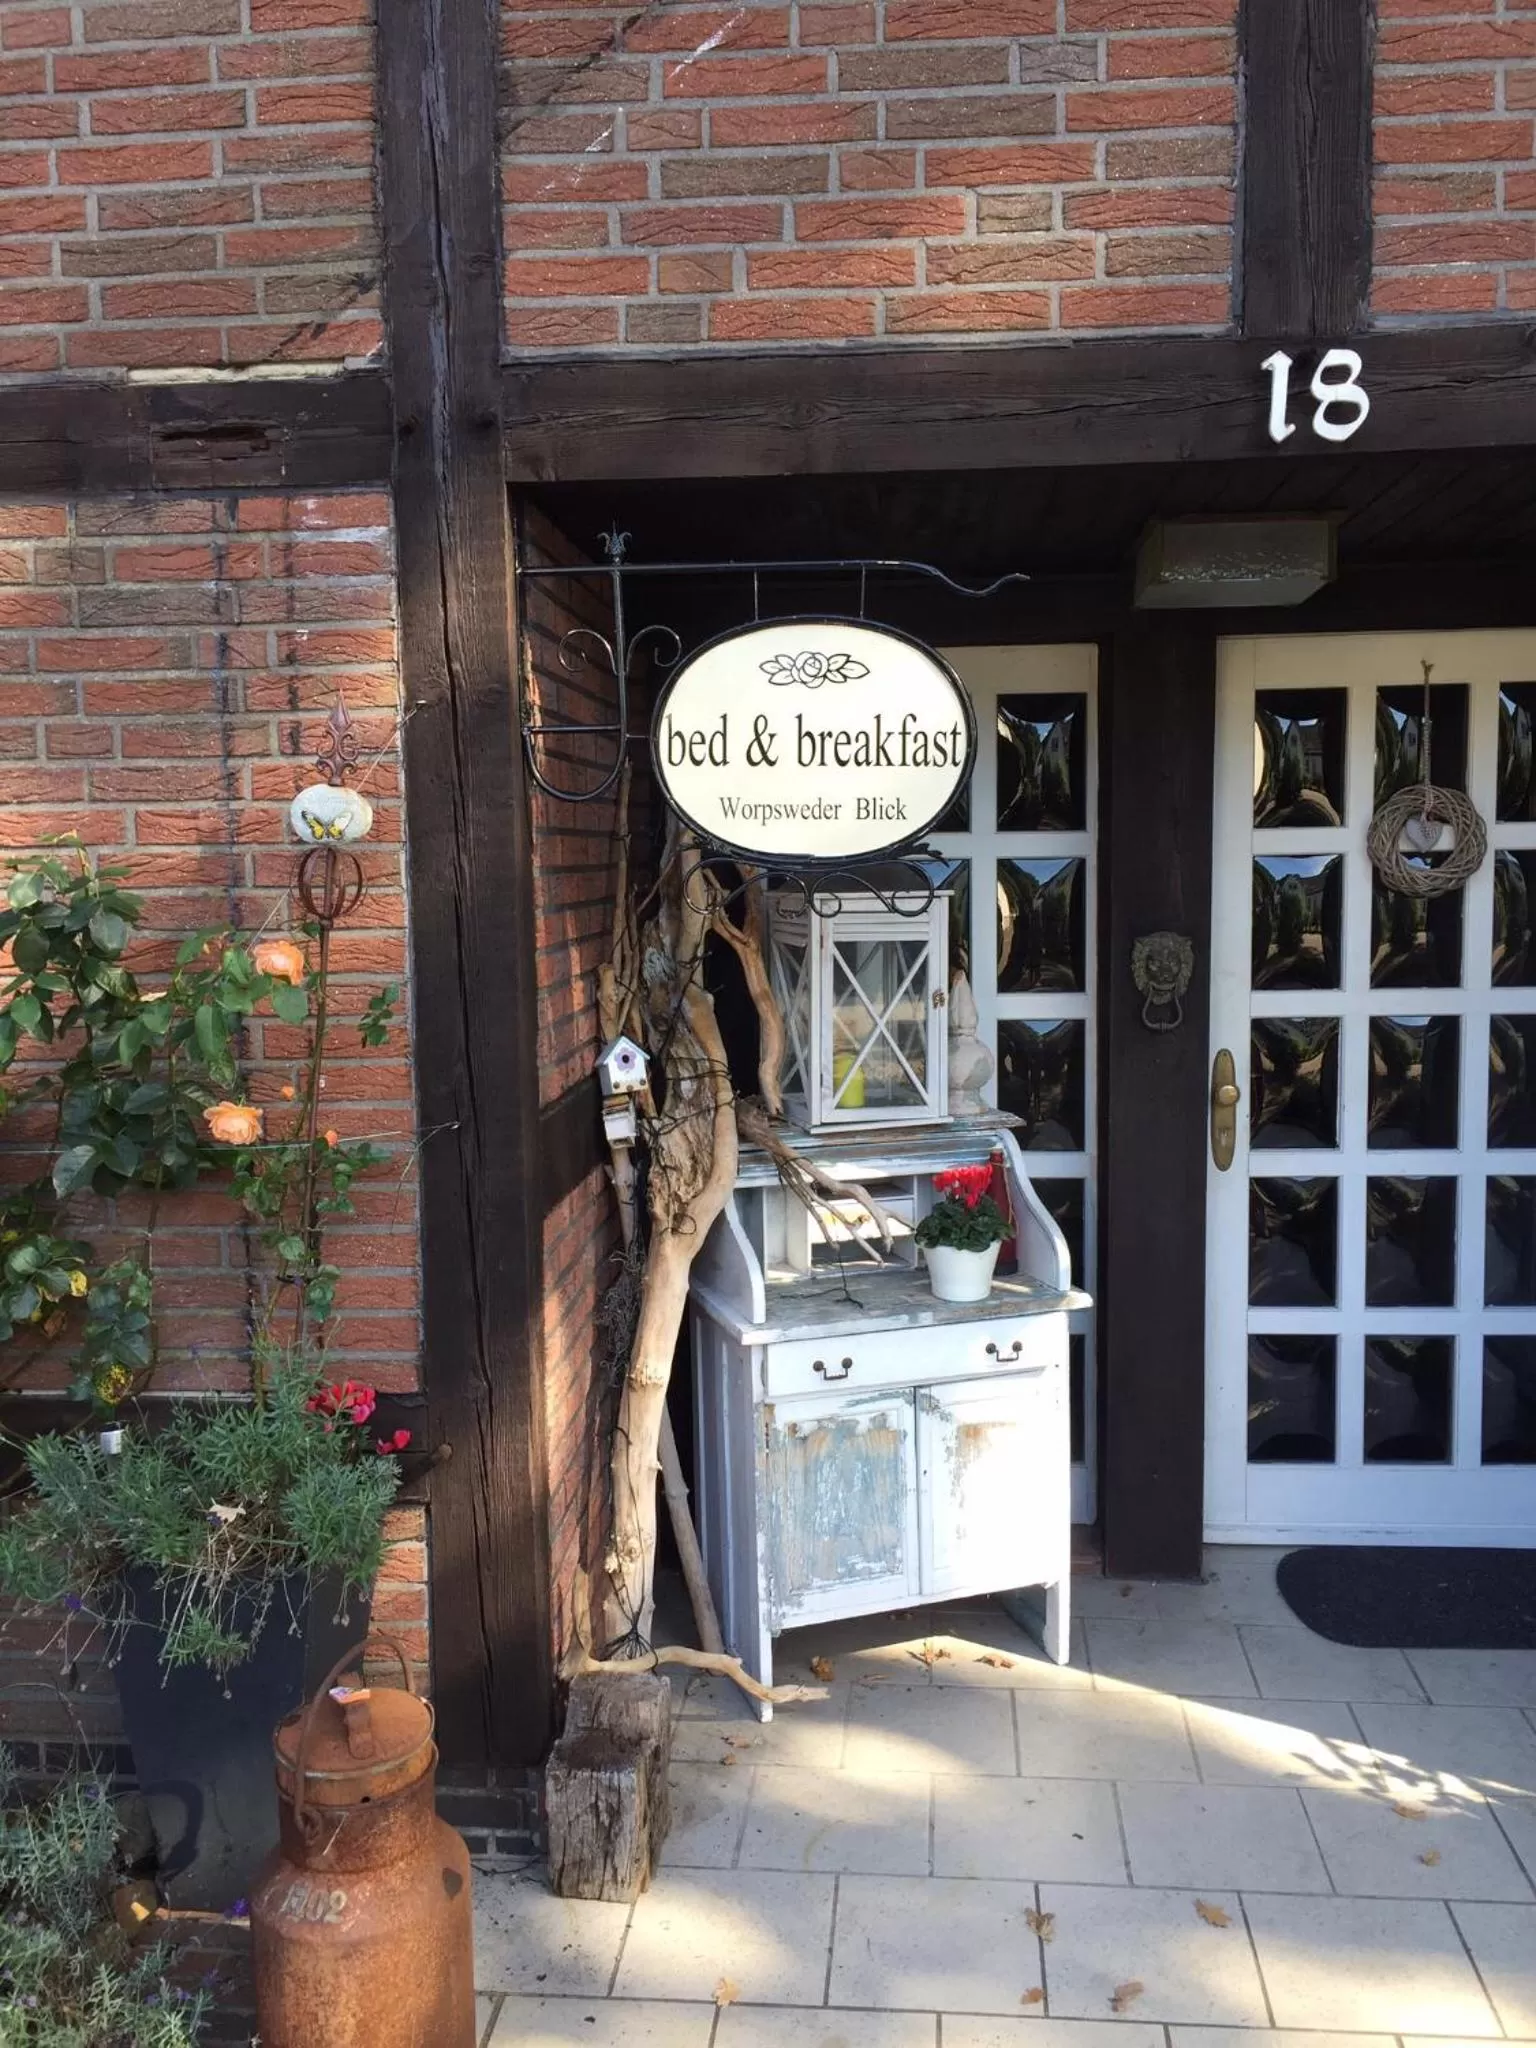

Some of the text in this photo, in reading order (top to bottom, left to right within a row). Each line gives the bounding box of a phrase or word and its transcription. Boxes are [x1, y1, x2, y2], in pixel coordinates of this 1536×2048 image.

[1260, 348, 1370, 443] 18
[665, 713, 962, 767] bed & breakfast
[718, 797, 907, 826] Worpsweder Blick
